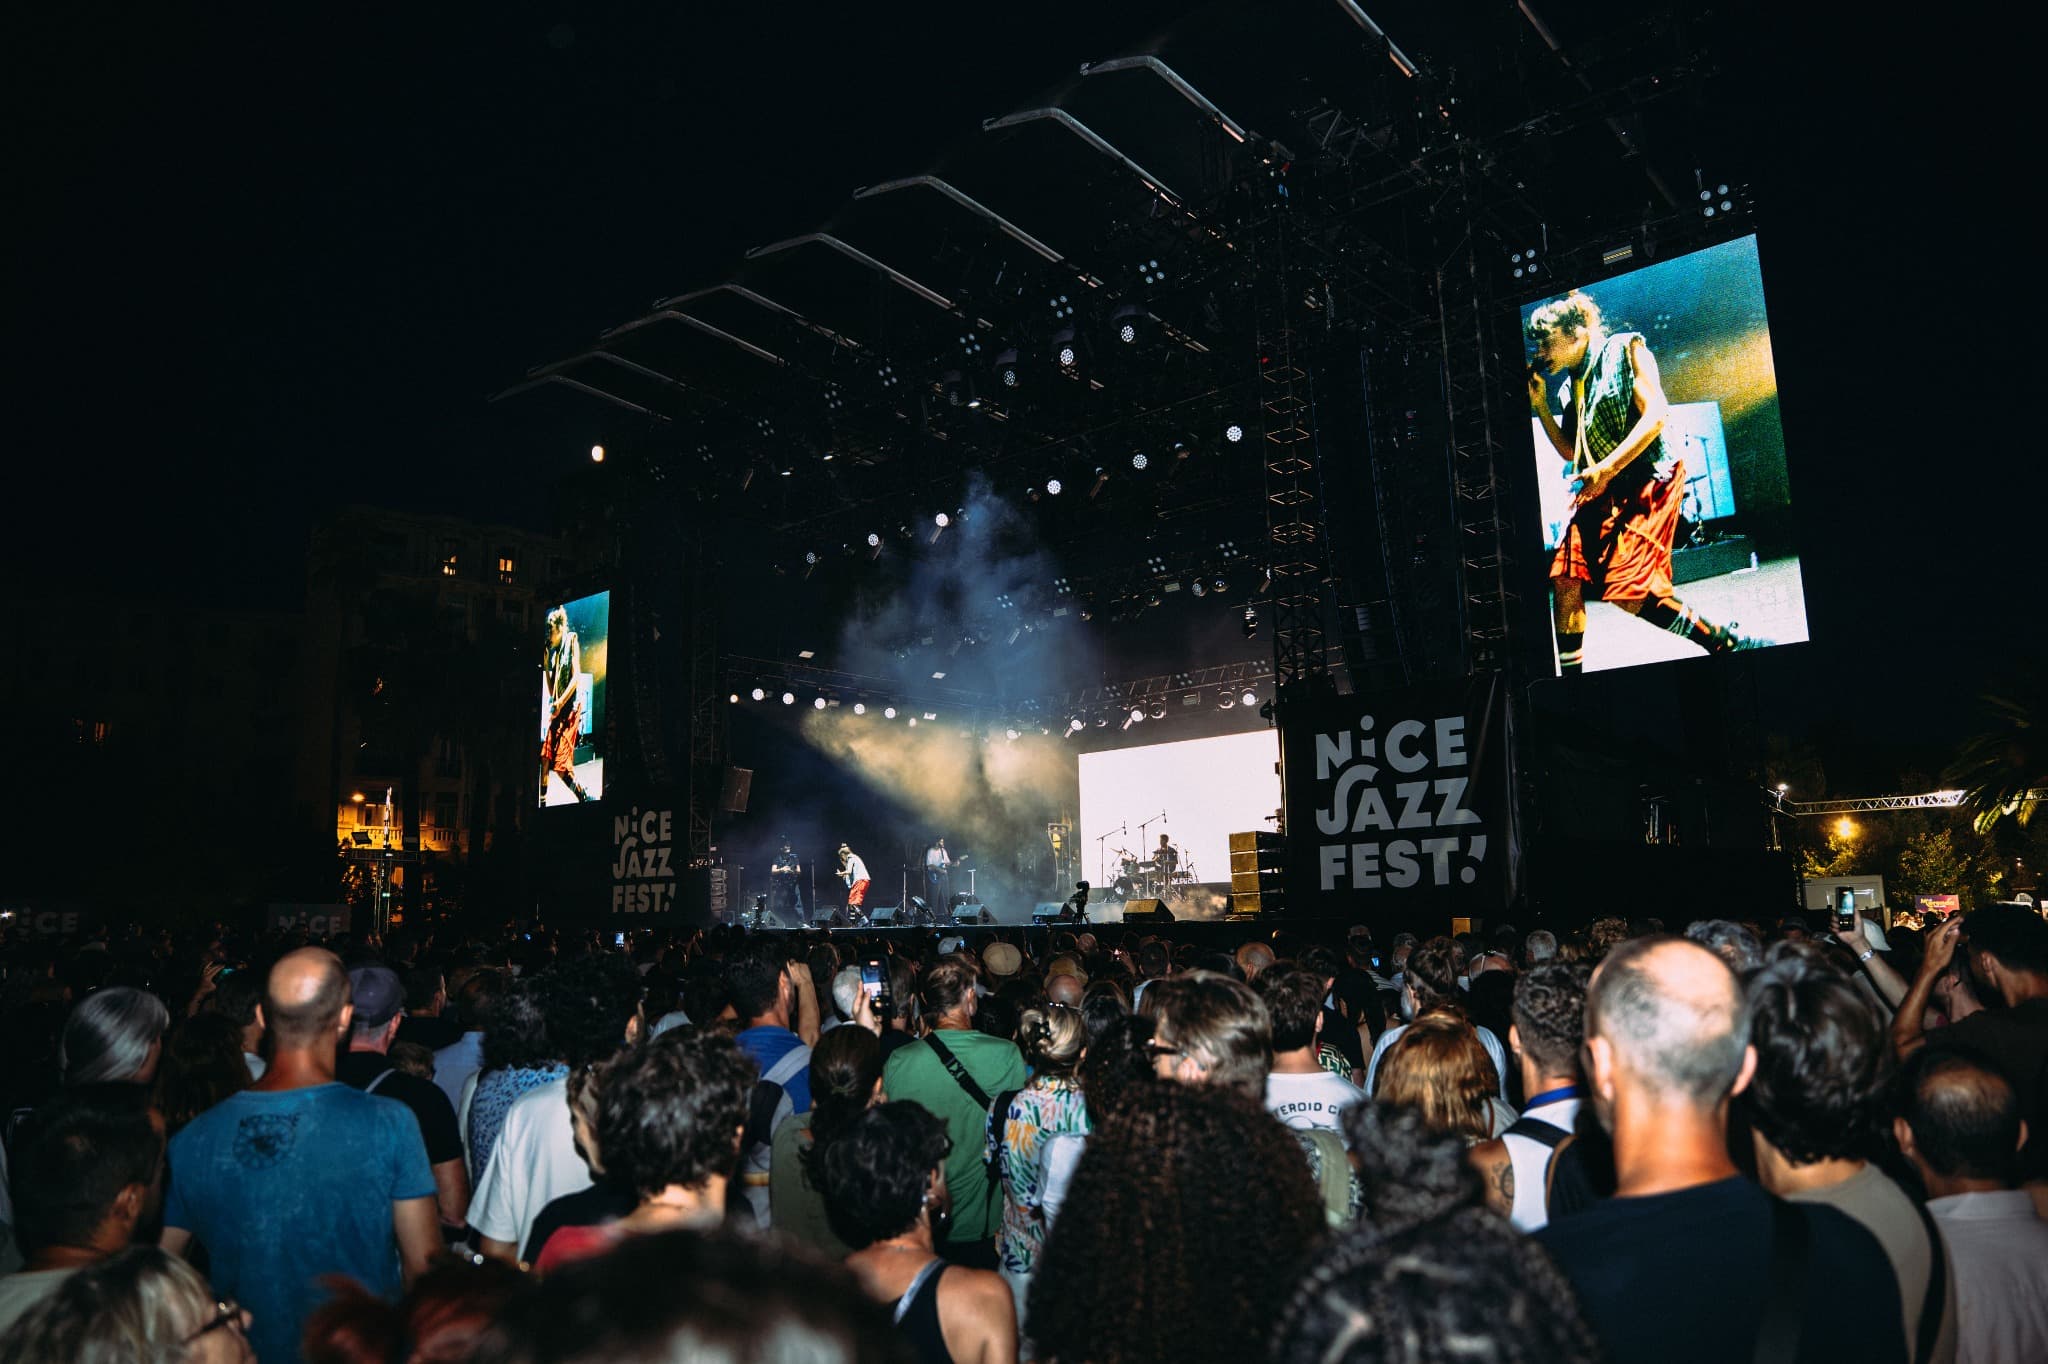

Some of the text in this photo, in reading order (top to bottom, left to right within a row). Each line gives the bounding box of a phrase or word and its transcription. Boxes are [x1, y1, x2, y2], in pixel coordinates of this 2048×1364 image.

[1315, 763, 1483, 836] JAZZ
[612, 836, 675, 880] JAZZ
[1319, 834, 1488, 891] FEST!
[612, 882, 677, 913] FEST!
[1274, 1102, 1322, 1116] EROID
